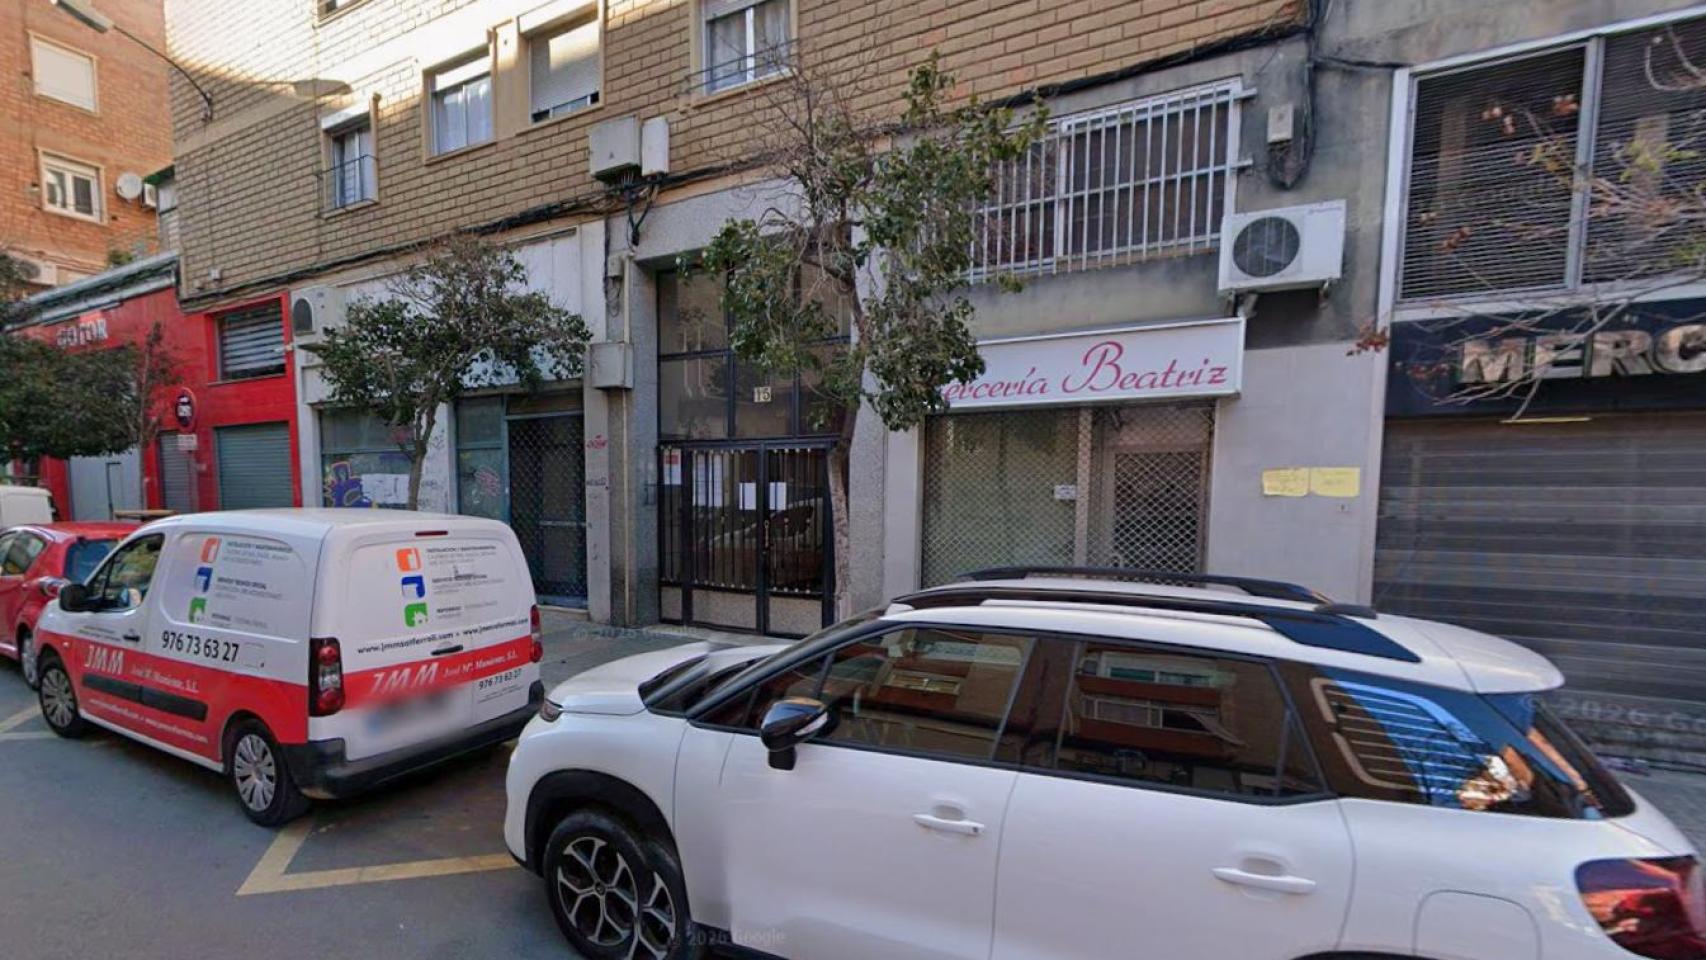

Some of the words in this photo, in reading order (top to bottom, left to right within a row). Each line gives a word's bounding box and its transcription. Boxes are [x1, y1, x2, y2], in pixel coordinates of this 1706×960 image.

[941, 367, 1049, 402] ercería
[1062, 340, 1228, 393] Beatriz
[162, 630, 184, 652] 976
[185, 635, 200, 655] 73
[203, 638, 219, 658] 63
[222, 641, 240, 662] 27
[478, 679, 493, 690] 976
[494, 674, 503, 684] 73
[504, 671, 513, 681] 63
